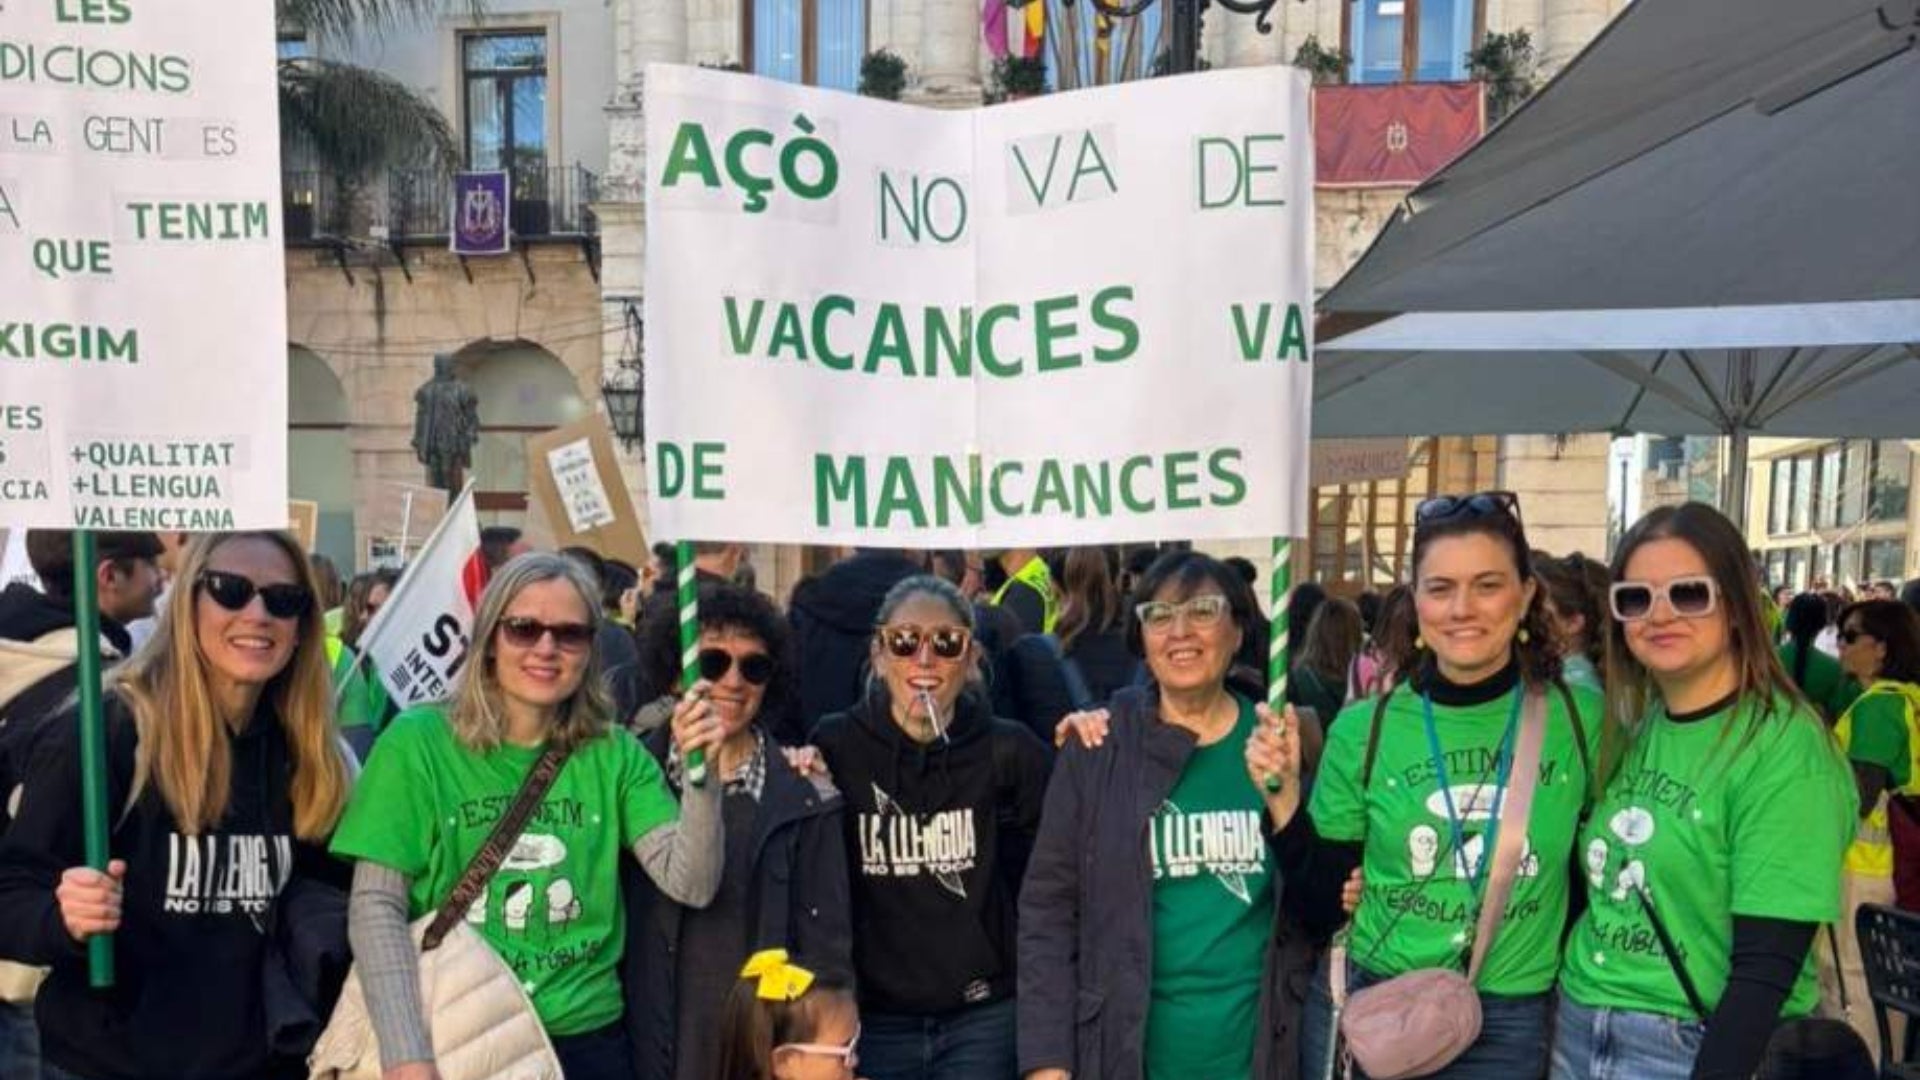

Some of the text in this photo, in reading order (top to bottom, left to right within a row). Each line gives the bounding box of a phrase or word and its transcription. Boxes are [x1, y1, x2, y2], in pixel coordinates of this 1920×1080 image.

[56, 0, 131, 24] LES
[0, 42, 190, 92] DICIONS
[12, 115, 237, 156] LA GENT ES
[662, 114, 1286, 243] AÇÒ NO VA DE
[126, 202, 268, 240] TENIM
[33, 239, 112, 278] QUE
[0, 323, 138, 363] XIGIM
[724, 286, 1308, 377] VACANCES VA
[0, 406, 42, 430] ES
[71, 442, 234, 470] +QUALITAT
[73, 472, 220, 498] +LLENGUA
[657, 442, 725, 499] DE
[815, 448, 1246, 528] MANCANCES
[74, 504, 234, 528] VALENCIANA
[1164, 811, 1265, 864] LLENGUA
[167, 833, 200, 897] LA
[863, 864, 889, 874] NO
[926, 860, 975, 874] TOCA
[1206, 862, 1265, 875] TOCA
[164, 898, 200, 913] NO
